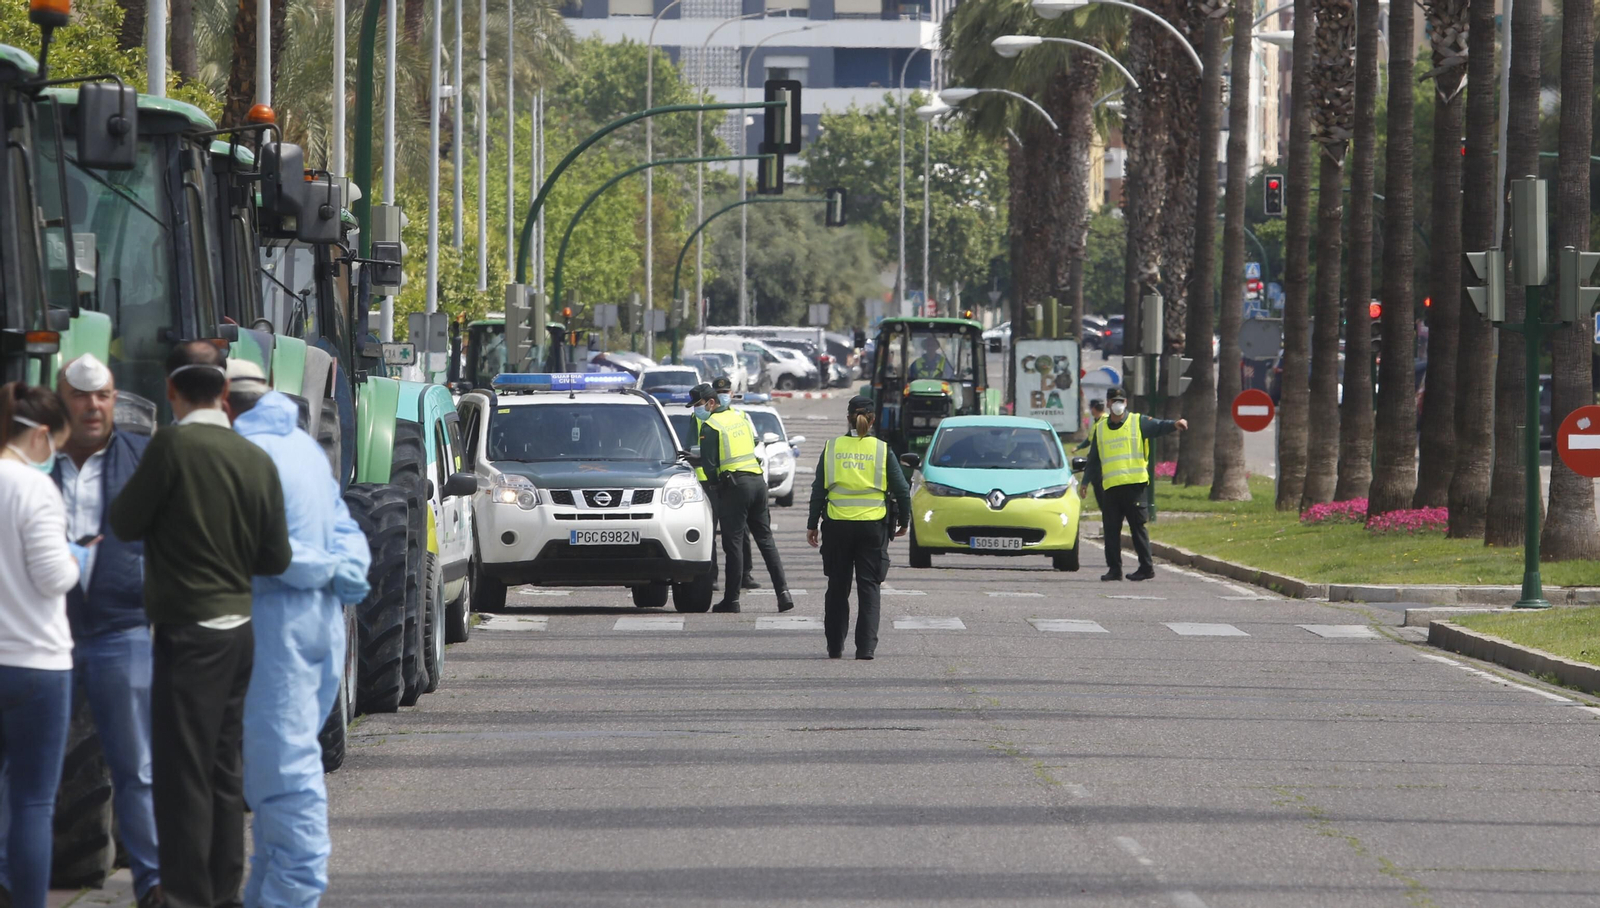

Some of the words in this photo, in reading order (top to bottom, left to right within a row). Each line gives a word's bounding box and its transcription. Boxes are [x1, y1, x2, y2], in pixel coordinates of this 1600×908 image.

[1030, 390, 1064, 409] BA
[835, 453, 874, 461] GUARDIA
[842, 461, 865, 470] CIVIL
